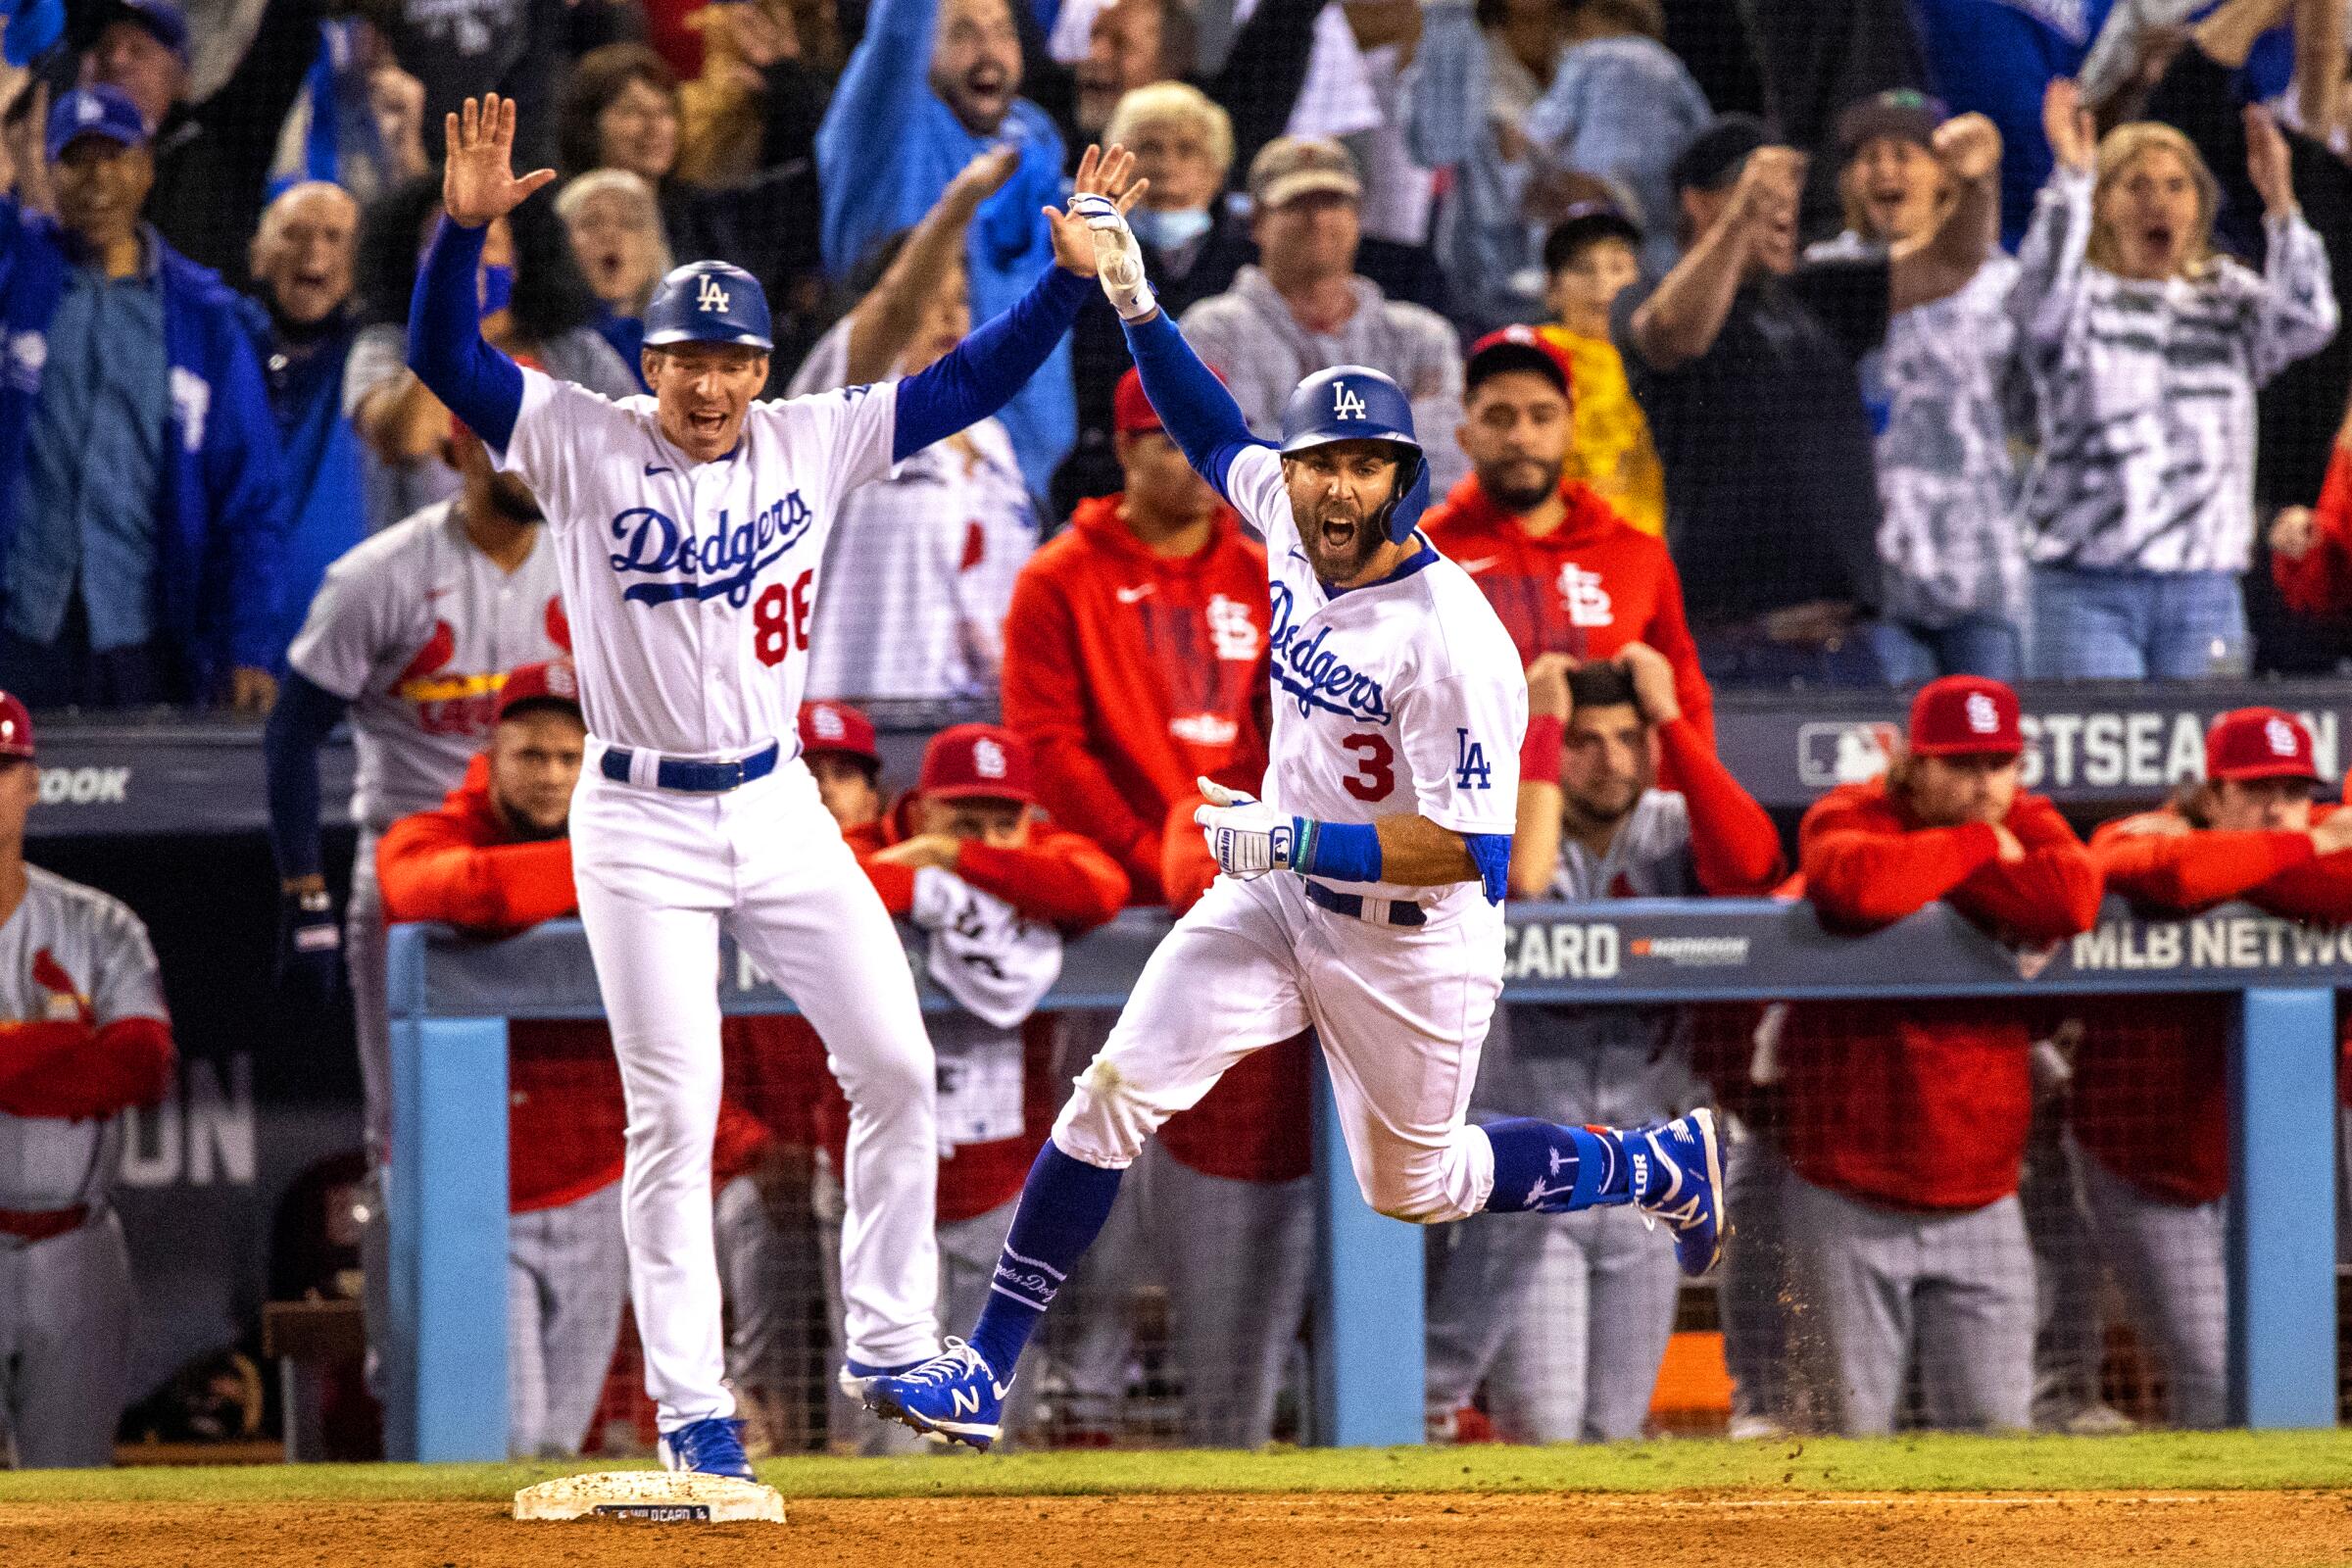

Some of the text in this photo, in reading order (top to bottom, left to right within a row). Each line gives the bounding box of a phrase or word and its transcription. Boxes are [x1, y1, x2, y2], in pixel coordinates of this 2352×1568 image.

[697, 274, 729, 312] LA
[1333, 381, 1366, 419] LA
[610, 489, 812, 609] Dodgers
[1343, 733, 1395, 802] 3
[1456, 727, 1491, 789] LA
[2019, 710, 2338, 786] STSEAN
[2073, 923, 2182, 969] MLB
